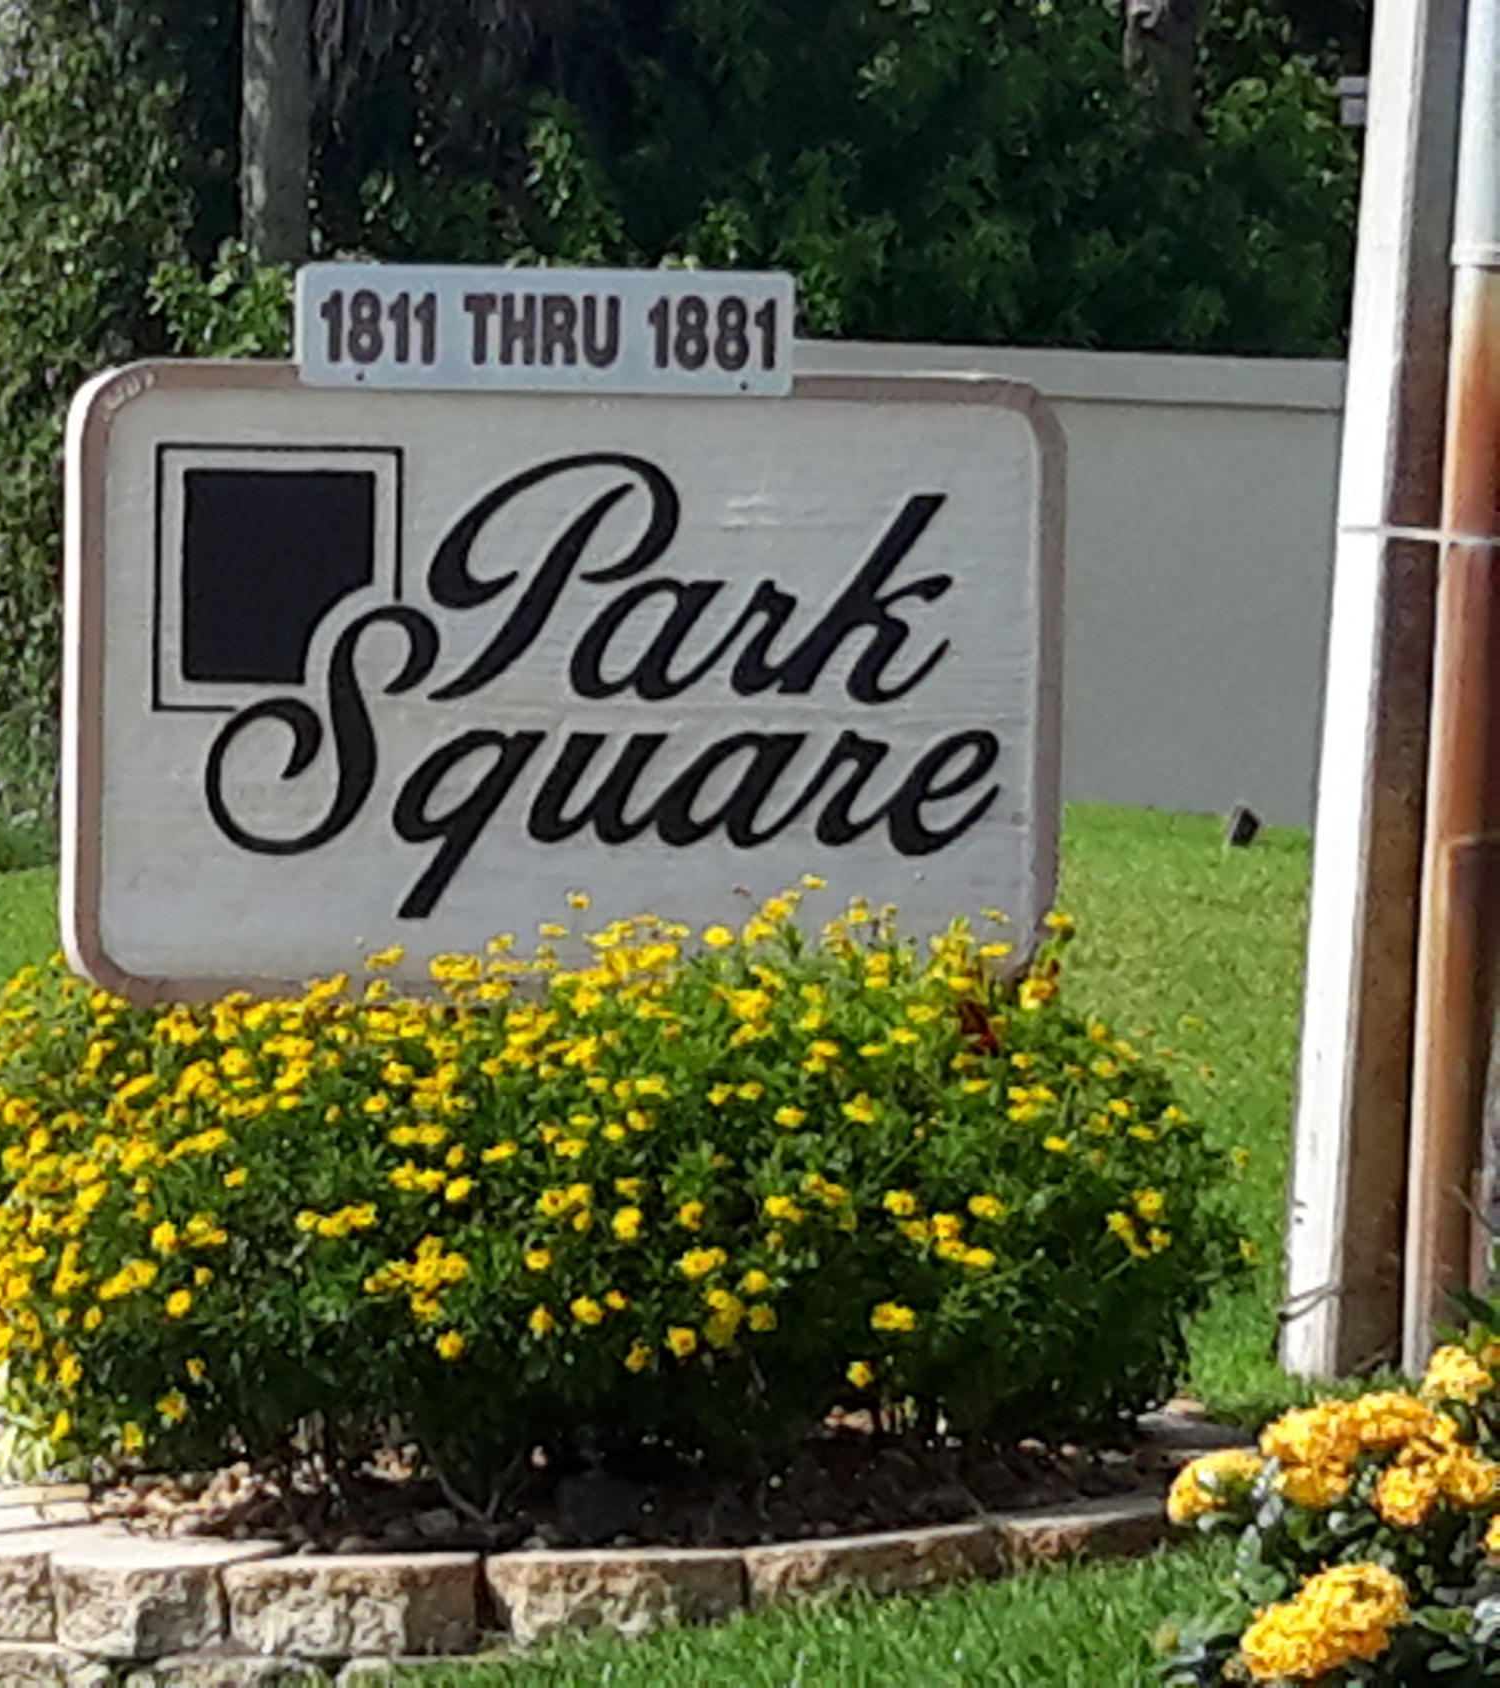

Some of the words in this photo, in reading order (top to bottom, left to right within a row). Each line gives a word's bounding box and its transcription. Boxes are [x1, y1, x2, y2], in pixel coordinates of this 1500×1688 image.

[321, 288, 437, 365] 1811
[464, 292, 621, 369] THRU
[648, 295, 778, 372] 1881
[427, 451, 954, 707] Park
[204, 604, 1002, 921] Square
